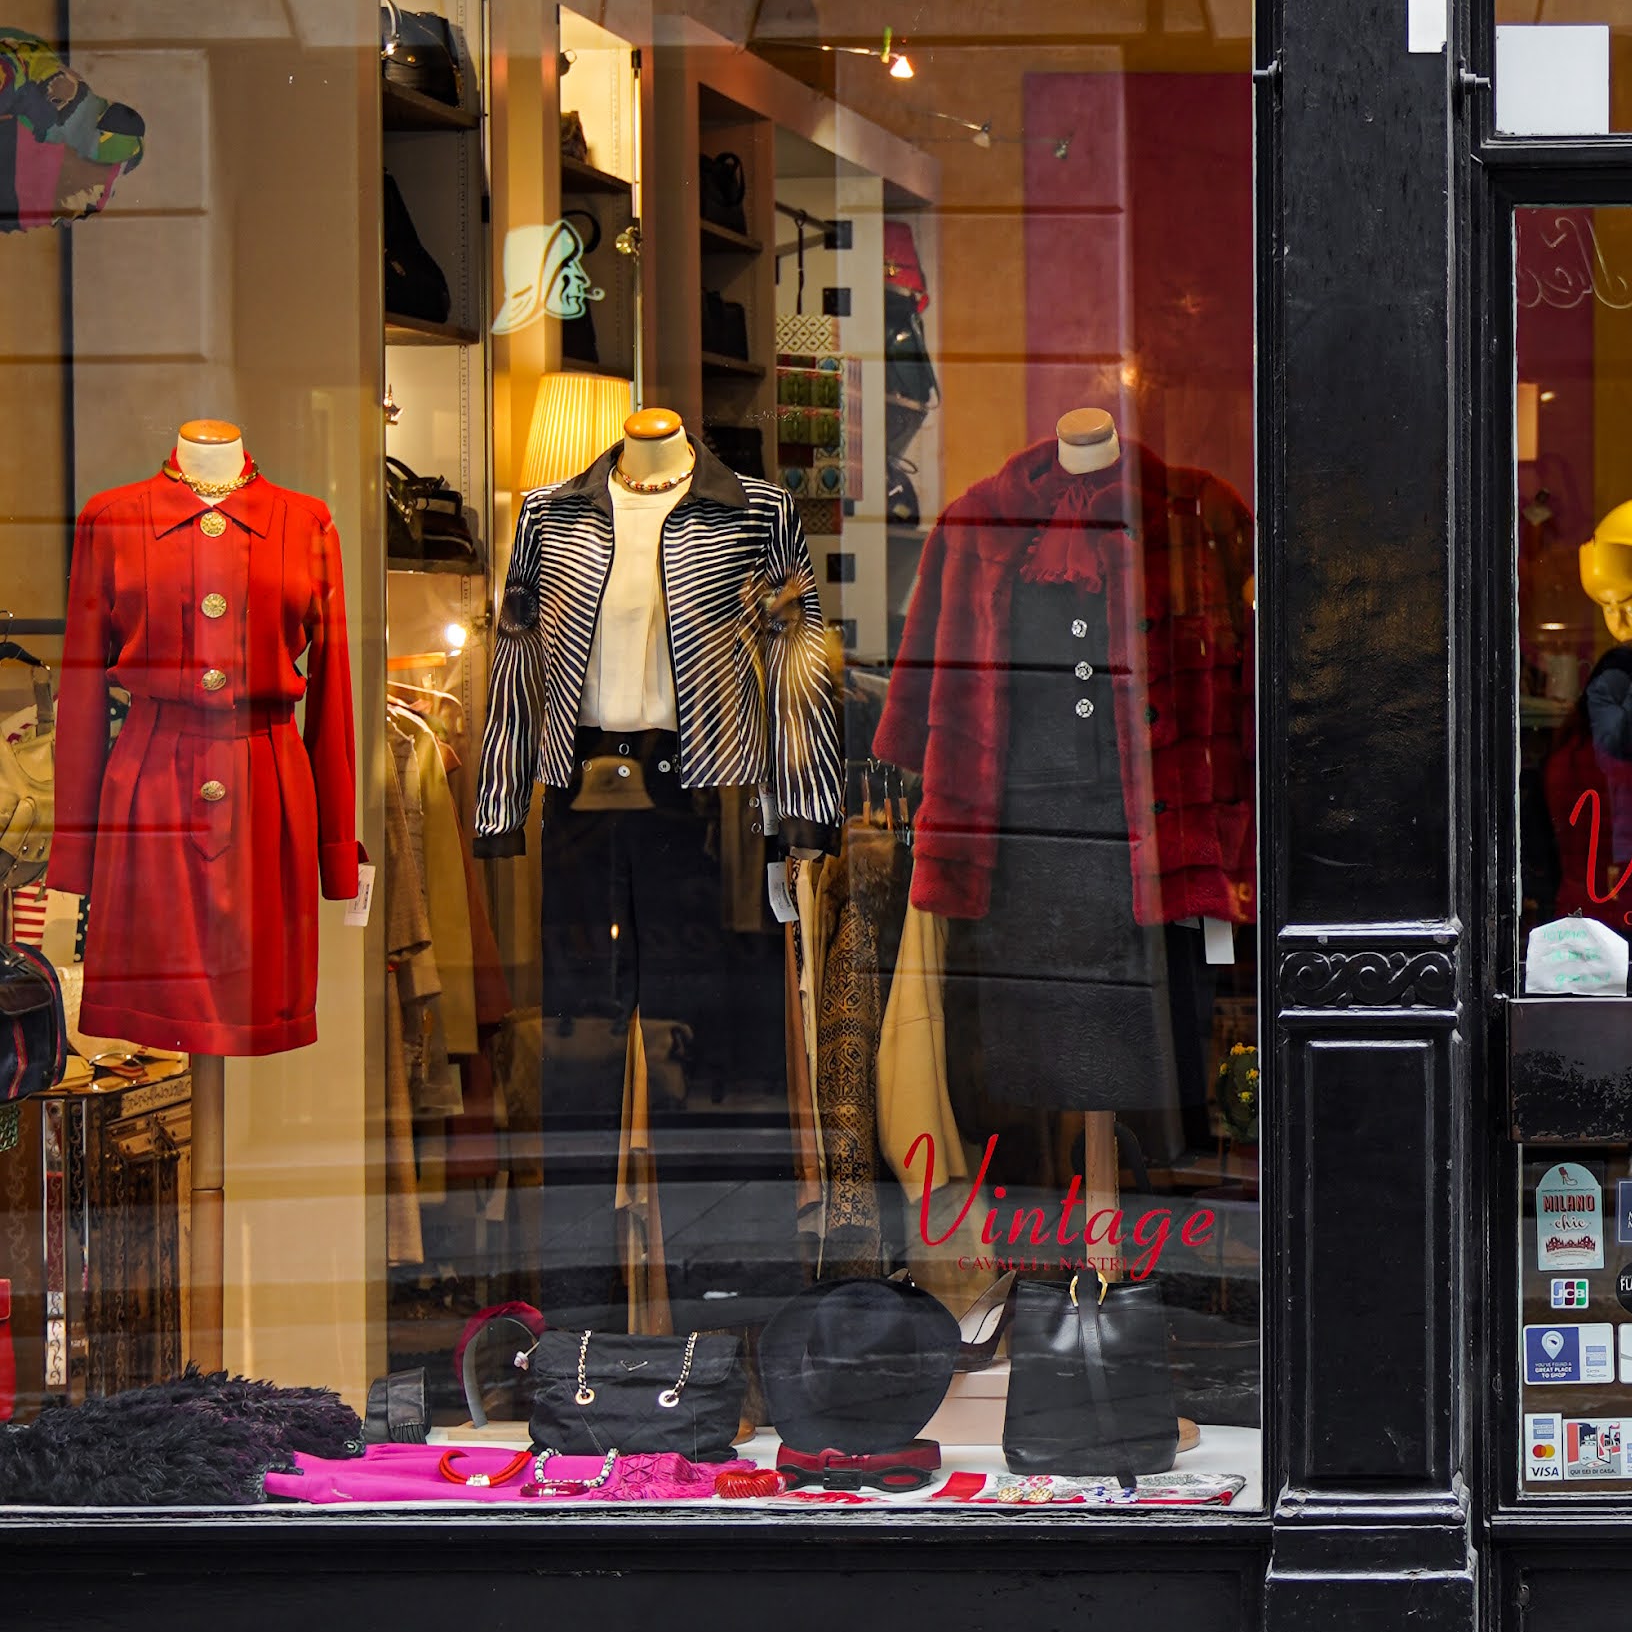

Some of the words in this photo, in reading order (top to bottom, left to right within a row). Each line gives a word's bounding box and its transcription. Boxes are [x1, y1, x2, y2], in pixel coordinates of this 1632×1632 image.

[903, 1133, 1215, 1282] Vintage
[1543, 1195, 1595, 1212] MILANO
[1555, 1214, 1585, 1230] chic
[958, 1256, 1037, 1272] CAVALLI
[1059, 1256, 1127, 1272] NASTRI
[1554, 1288, 1585, 1298] JCB
[1531, 1467, 1559, 1477] VISA
